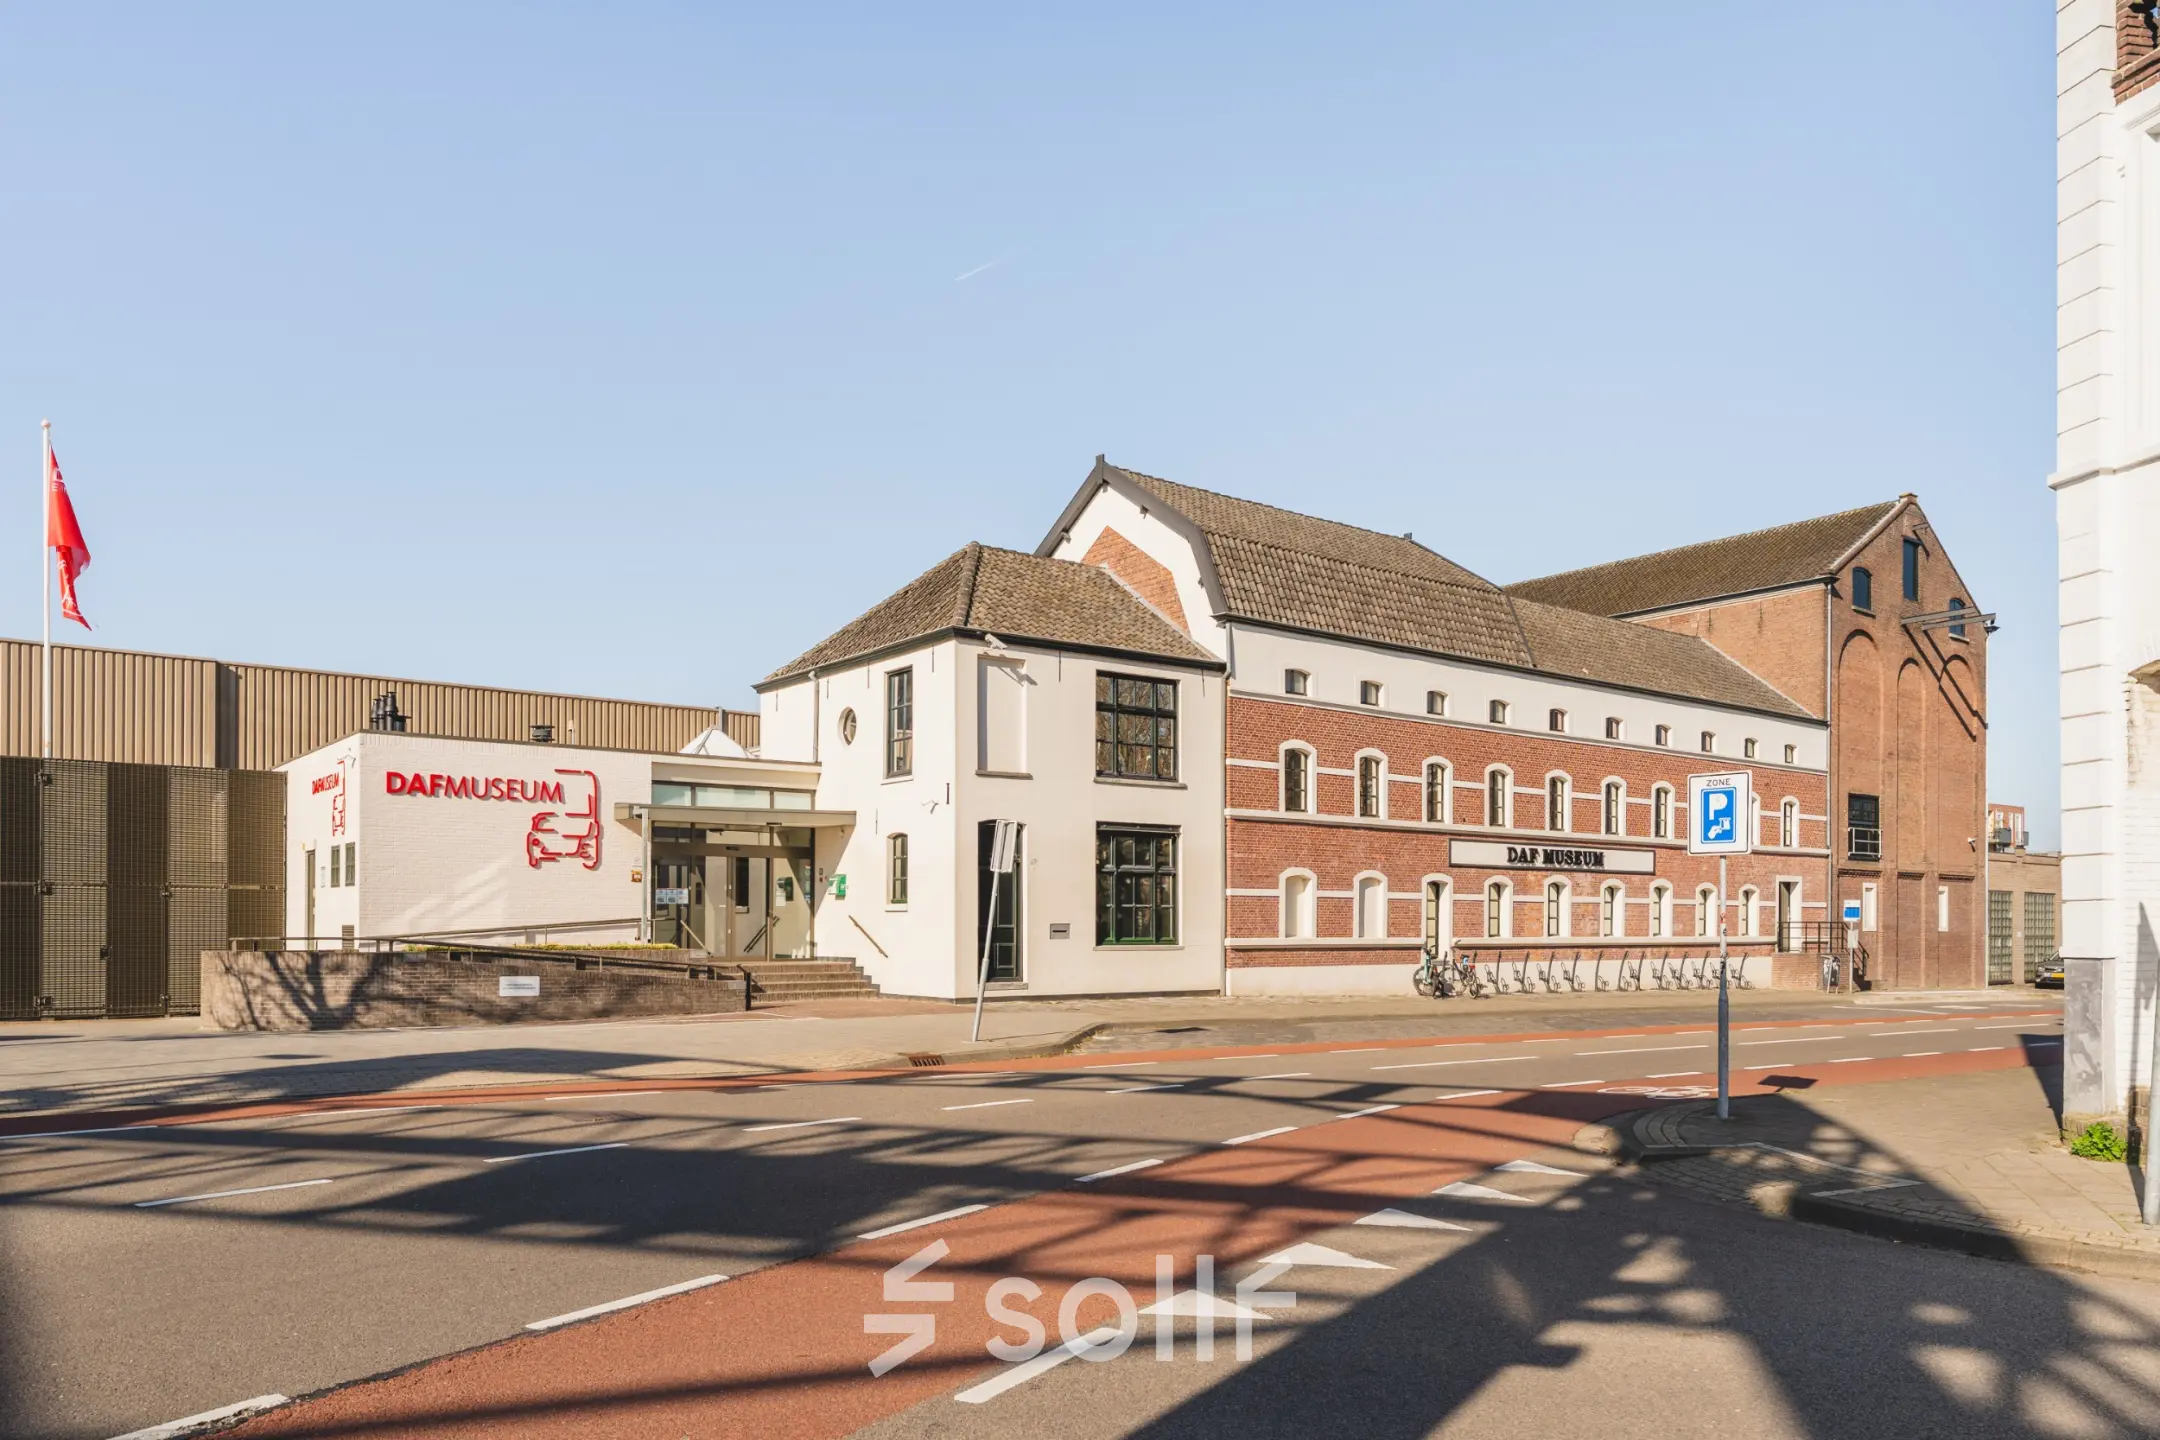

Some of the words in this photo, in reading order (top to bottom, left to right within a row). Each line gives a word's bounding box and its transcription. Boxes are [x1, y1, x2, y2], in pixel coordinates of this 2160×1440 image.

[386, 771, 564, 803] DAFMUSEUM
[1706, 778, 1731, 787] ZONE
[1709, 793, 1728, 820] P
[1507, 846, 1540, 864] DAF
[1542, 848, 1605, 867] MUSEUM
